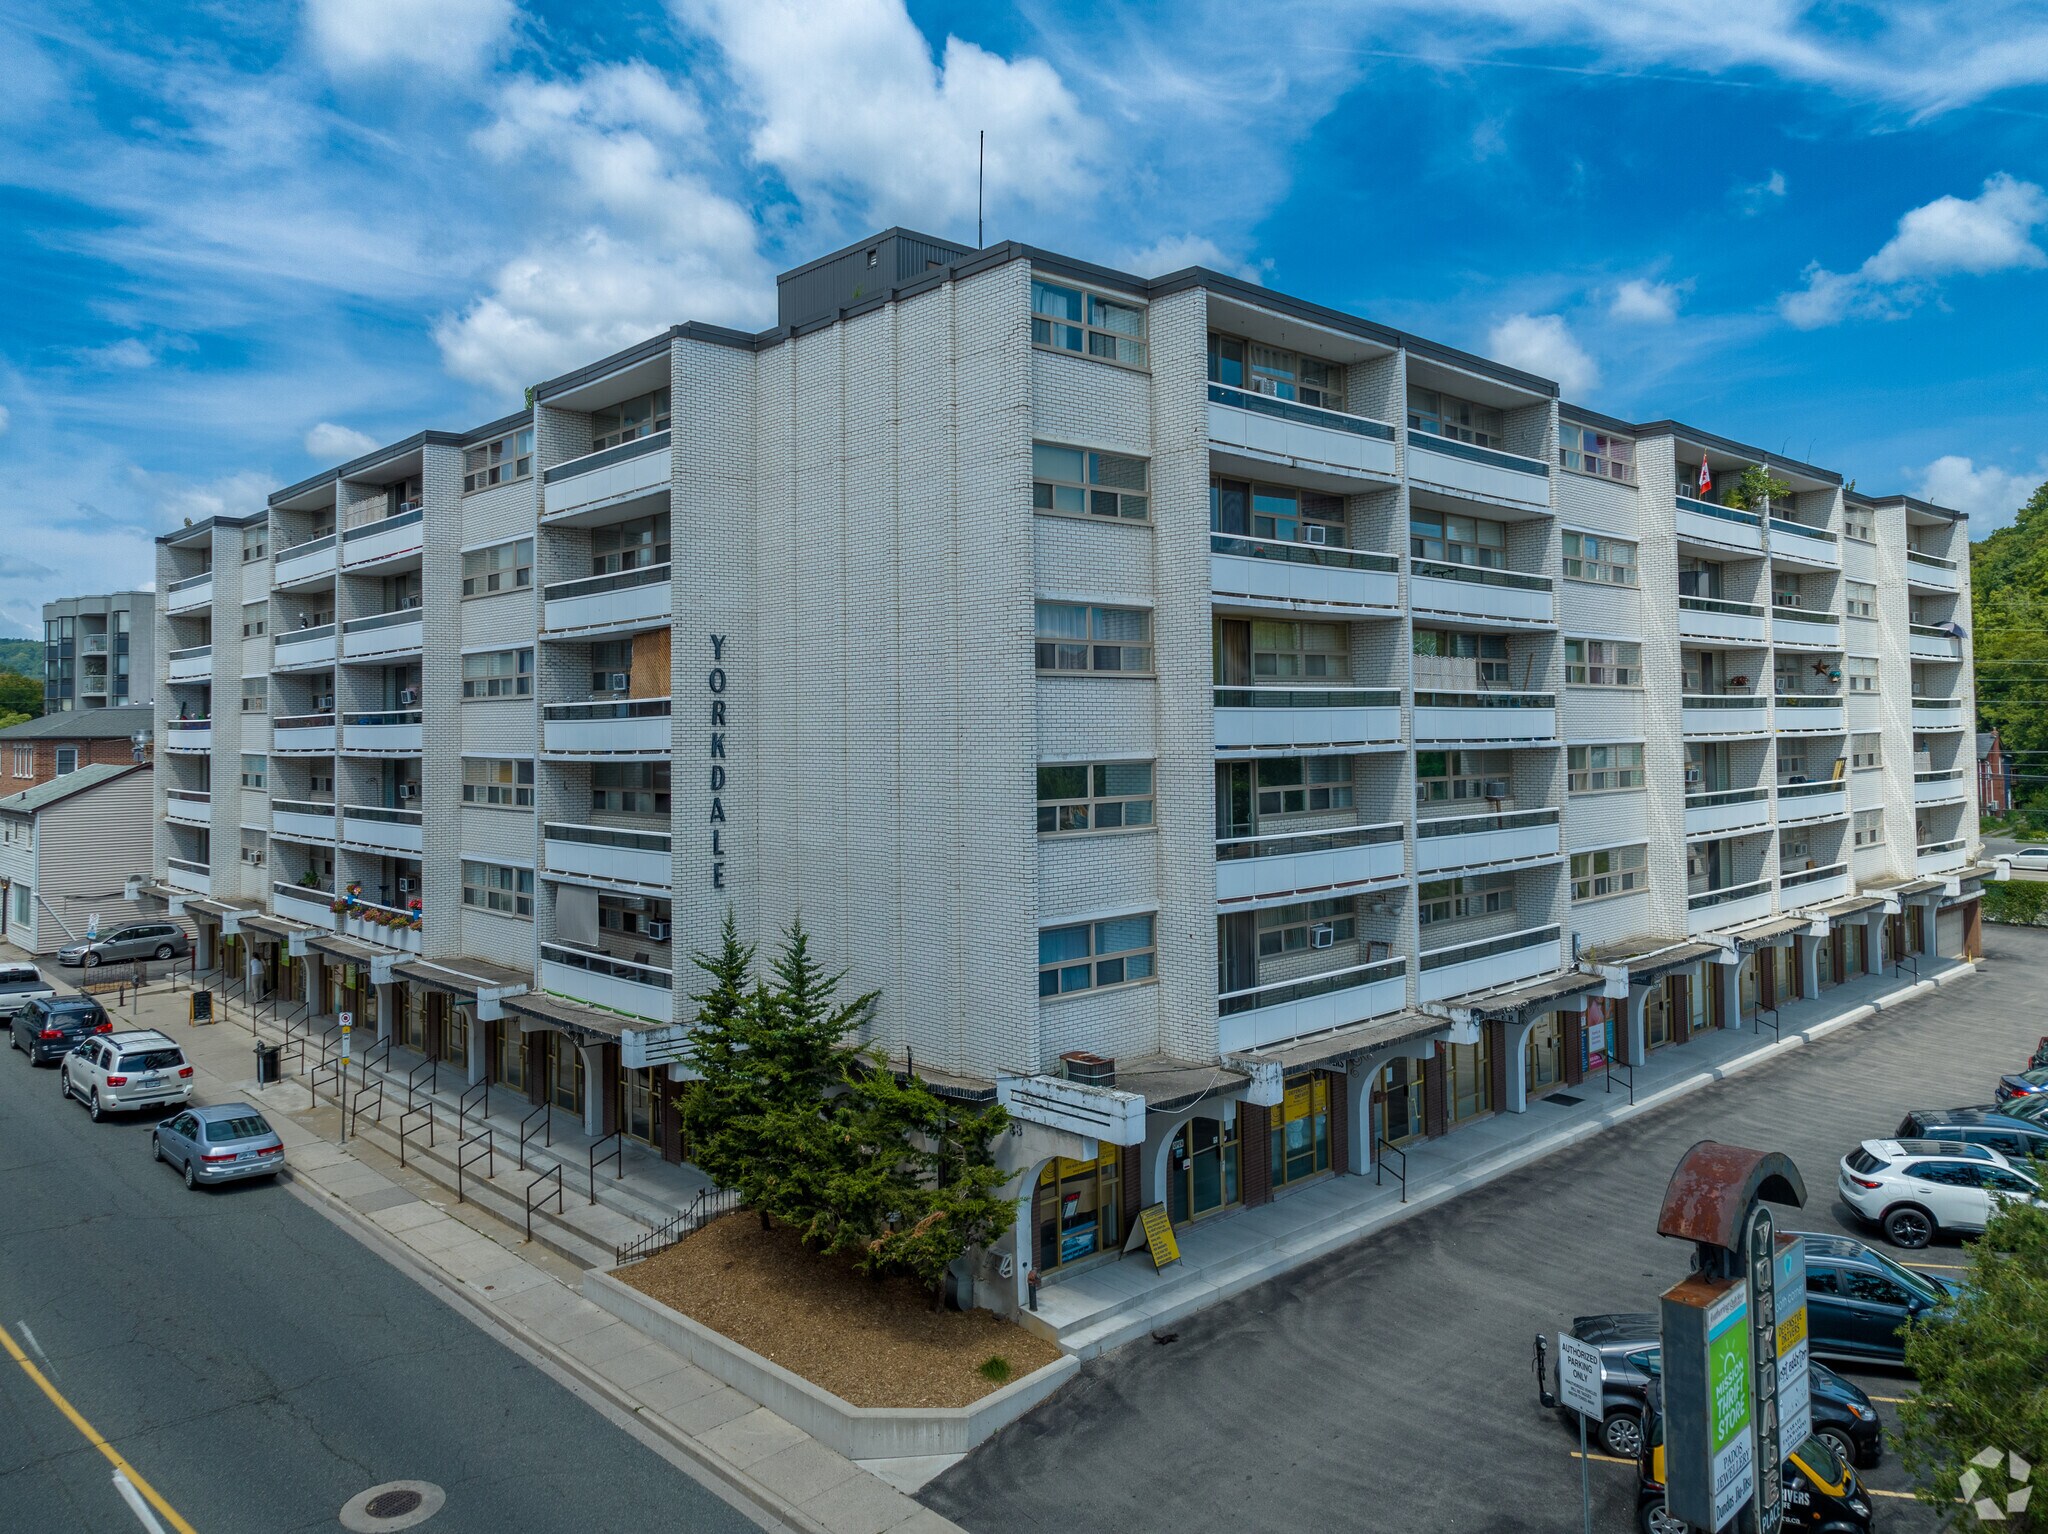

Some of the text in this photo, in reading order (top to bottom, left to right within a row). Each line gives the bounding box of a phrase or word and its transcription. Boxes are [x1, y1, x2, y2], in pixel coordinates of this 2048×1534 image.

[709, 634, 726, 888] YORKDALE
[1778, 1310, 1802, 1337] DEFENSIVE
[1781, 1323, 1800, 1345] DRIVERS
[1562, 1342, 1598, 1365] AUTHORIZED
[1567, 1356, 1593, 1374] PARKING
[1754, 1221, 1780, 1509] YORKDALE
[1572, 1370, 1588, 1382] ONLY
[1715, 1357, 1744, 1399] MISSION
[1717, 1372, 1744, 1419] THRIFT
[1718, 1393, 1746, 1441] STORE
[1716, 1448, 1750, 1492] JEWELLERY
[1723, 1442, 1743, 1469] PADOS
[1716, 1493, 1734, 1522] Dundas
[1761, 1502, 1781, 1534] PLACE
